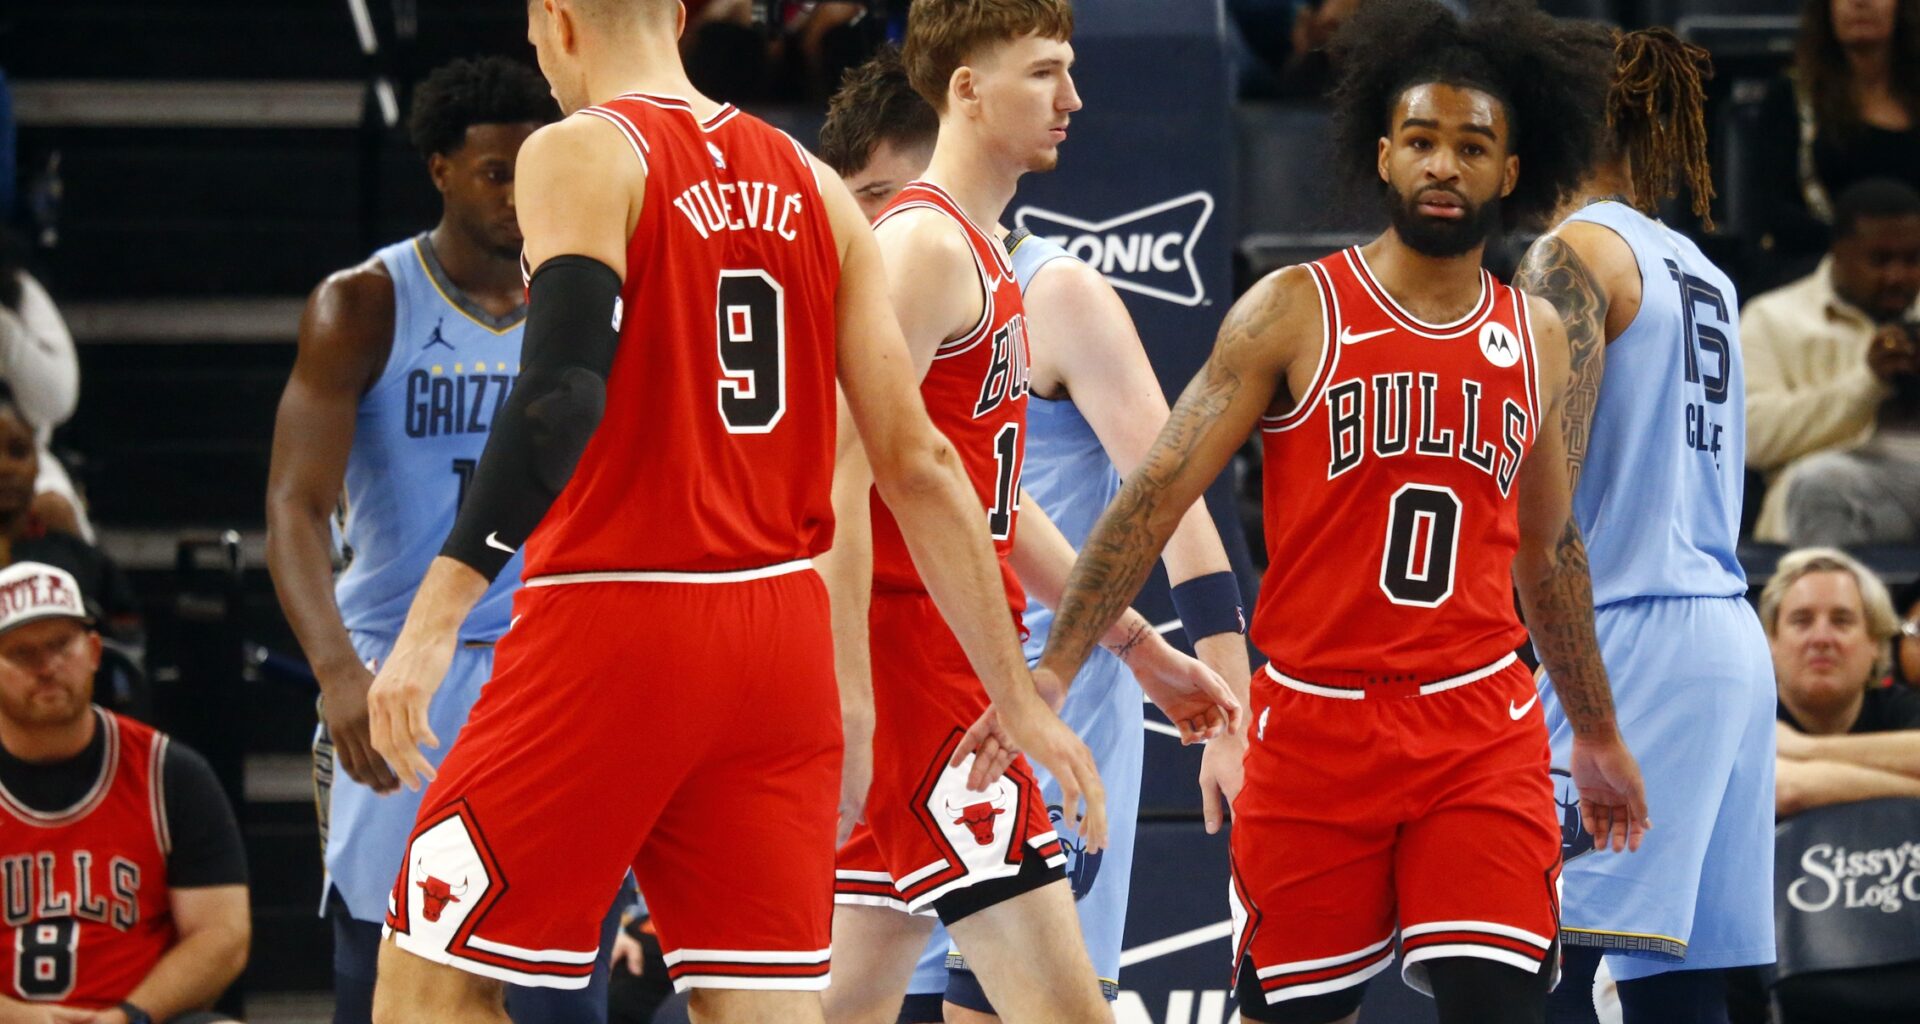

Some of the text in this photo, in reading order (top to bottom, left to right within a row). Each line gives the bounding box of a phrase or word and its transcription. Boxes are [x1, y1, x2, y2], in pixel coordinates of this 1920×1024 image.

[673, 179, 802, 241] VUEVIĆ
[716, 269, 786, 434] 9
[405, 368, 518, 439] GRIZZ
[1326, 371, 1528, 500] BULLS
[1379, 482, 1463, 608] 0
[1844, 878, 1903, 913] Log
[14, 915, 80, 1001] 8
